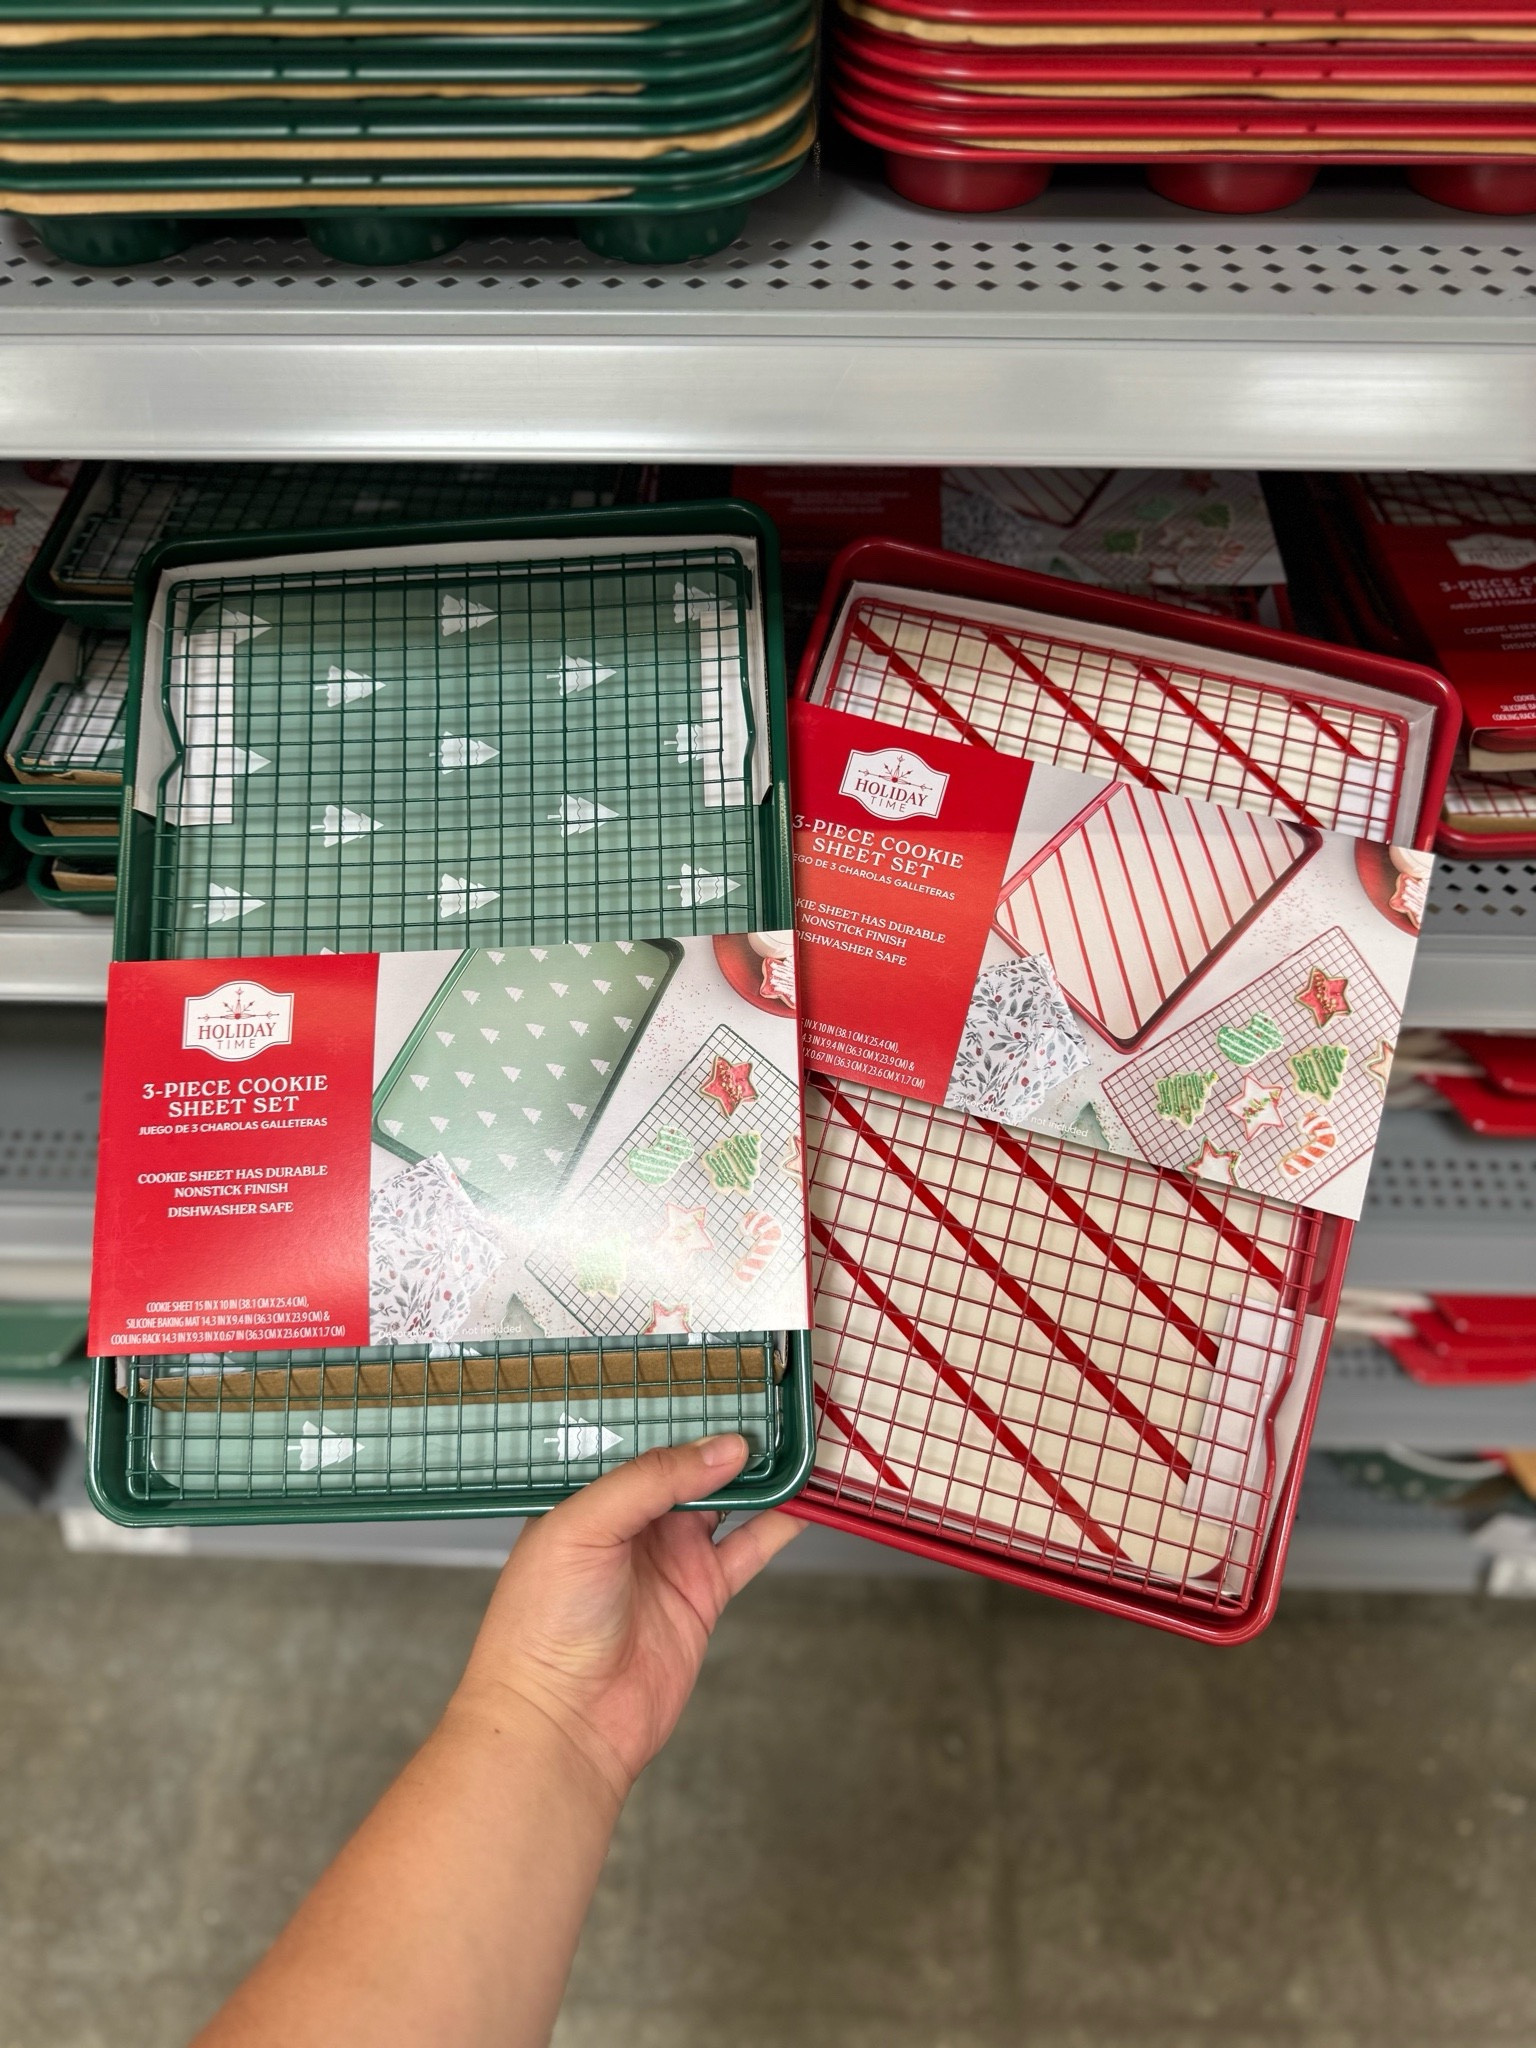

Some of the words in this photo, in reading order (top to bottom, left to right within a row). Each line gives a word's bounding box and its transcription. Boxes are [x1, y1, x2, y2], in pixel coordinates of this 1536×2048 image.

[855, 778, 928, 807] HOLIDAY
[871, 796, 906, 812] TIME
[792, 814, 875, 847] 3-PIECE
[881, 837, 963, 869] COOKIE
[813, 838, 885, 866] SHEET
[891, 857, 934, 879] SET
[793, 854, 813, 864] EGO
[815, 858, 828, 868] DE
[830, 862, 837, 870] 3
[839, 865, 892, 885] CHAROLAS
[894, 879, 955, 900] GALLETERAS
[796, 898, 816, 911] KIE
[818, 904, 859, 921] SHEET
[861, 914, 886, 928] HAS
[888, 921, 946, 944] DURABLE
[802, 914, 863, 937] NONSTICK
[865, 930, 907, 948] FINISH
[876, 950, 907, 966] SAFE
[198, 1022, 276, 1040] HOLIDAY
[819, 1023, 827, 1032] 10
[217, 1039, 255, 1050] TIME
[802, 1033, 812, 1043] 4.3
[908, 1061, 915, 1071] &
[142, 1080, 231, 1099] 3-PIECE
[238, 1075, 328, 1094] COOKIE
[168, 1098, 246, 1118] SHEET
[253, 1095, 299, 1114] SET
[138, 1125, 173, 1136] JUEGO
[174, 1124, 189, 1134] DE
[191, 1124, 198, 1133] 3
[200, 1120, 258, 1133] CHAROLAS
[261, 1118, 327, 1130] GALLETERAS
[1031, 1116, 1047, 1126] not
[1050, 1119, 1088, 1137] included
[138, 1171, 188, 1184] COOKIE
[189, 1169, 233, 1182] SHEET
[235, 1168, 263, 1180] HAS
[266, 1165, 328, 1178] DURABLE
[174, 1185, 242, 1198] NONSTICK
[244, 1183, 288, 1195] FINISH
[168, 1203, 257, 1218] DISHWASHER
[260, 1202, 294, 1214] SAFE
[146, 1301, 171, 1312] COOKIE
[172, 1301, 193, 1311] SHEET
[194, 1300, 203, 1311] 15
[204, 1300, 212, 1310] IN
[212, 1300, 218, 1310] X
[220, 1299, 228, 1310] 10
[229, 1299, 237, 1309] IN
[239, 1298, 256, 1309] (38.1
[257, 1298, 269, 1308] CM
[270, 1298, 275, 1308] X
[276, 1297, 292, 1308] 25.4
[126, 1318, 158, 1329] SILICONE
[158, 1317, 184, 1328] BAKING
[185, 1316, 200, 1327] MAT
[201, 1316, 216, 1326] 14.3
[232, 1314, 244, 1325] 9.4
[254, 1313, 272, 1324] (36.3
[273, 1313, 285, 1323] CM
[285, 1312, 291, 1322] X
[292, 1312, 307, 1322] 23.9
[323, 1310, 330, 1321] &
[111, 1334, 141, 1345] COOLING
[142, 1333, 161, 1344] RACK
[162, 1333, 176, 1343] 14.3
[193, 1332, 203, 1342] 9.3
[219, 1331, 235, 1341] 0.67
[245, 1329, 263, 1340] (36.3
[264, 1329, 276, 1339] CM
[277, 1328, 283, 1338] X
[284, 1328, 299, 1338] 23.6
[300, 1327, 312, 1338] CM
[312, 1327, 319, 1337] X
[319, 1326, 330, 1337] 1.7
[462, 1326, 478, 1335] not
[481, 1324, 522, 1334] included
